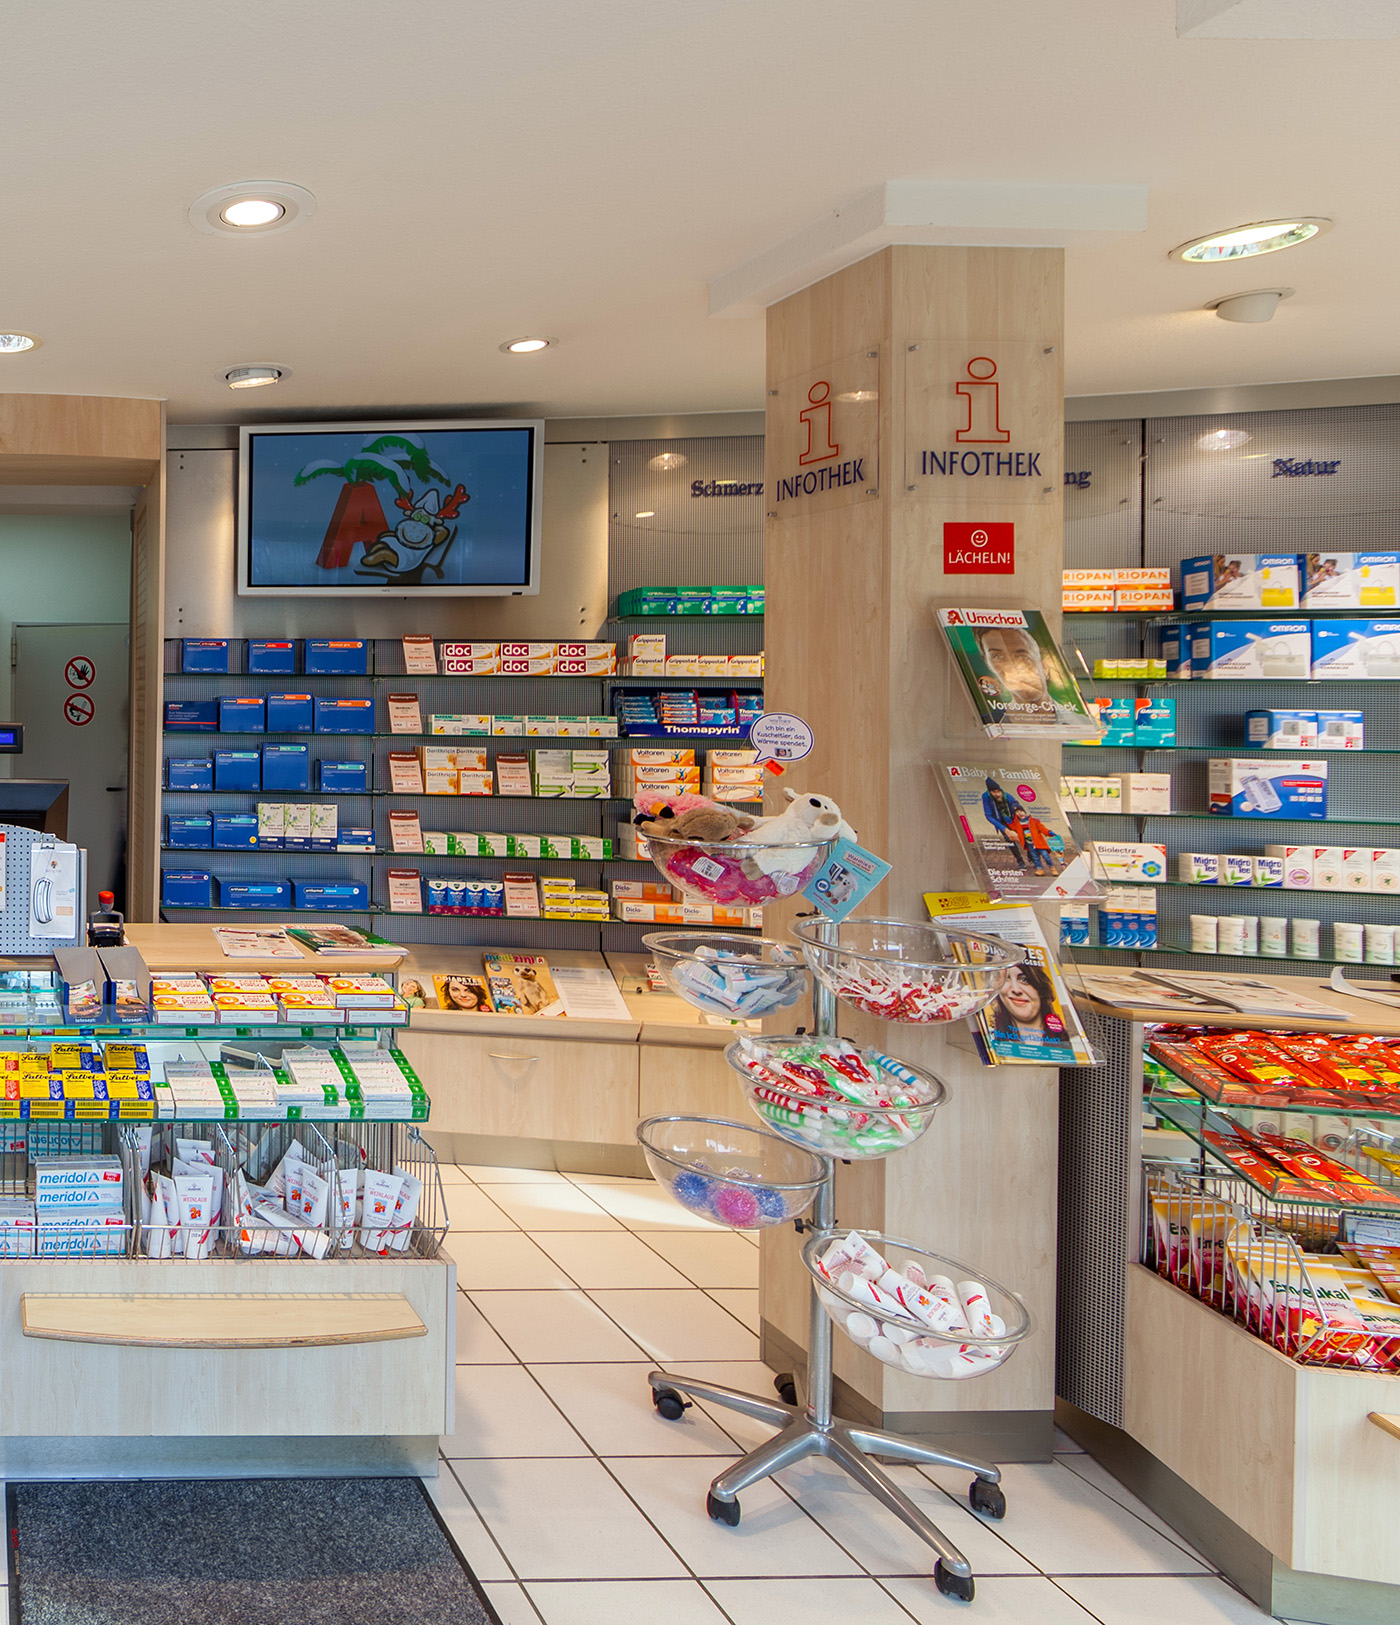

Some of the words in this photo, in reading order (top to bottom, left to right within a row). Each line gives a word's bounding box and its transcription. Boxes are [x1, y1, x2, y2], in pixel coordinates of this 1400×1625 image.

[921, 451, 1042, 477] INFOTHEK
[1271, 458, 1341, 479] Natur
[776, 458, 864, 502] INFOTHEK
[691, 480, 764, 497] Schmerz
[948, 549, 1011, 565] LÄCHELN!
[1064, 572, 1112, 581] RIOPAN
[1117, 570, 1168, 580] RIOPAN
[1064, 593, 1113, 602] RIOPAN
[1121, 591, 1171, 601] RIOPAN
[966, 612, 1023, 626] Umschau
[504, 645, 527, 655] doc
[560, 645, 585, 655] doc
[448, 660, 471, 670] doc
[560, 661, 585, 671] doc
[988, 700, 1078, 714] Vorsorge-Check
[665, 725, 739, 734] Thomapyrin
[757, 732, 792, 740] Kuscheltier,
[780, 740, 807, 748] spendet.
[962, 768, 988, 778] Baby
[1000, 769, 1041, 780] Familie
[1098, 845, 1137, 854] Biolectra
[847, 853, 872, 869] Warmies
[1194, 857, 1217, 867] Migro
[1228, 858, 1251, 868] Migro
[1258, 859, 1282, 870] Migro
[1204, 864, 1217, 872] Tee
[1239, 866, 1251, 874] Tee
[1270, 867, 1282, 875] Tee
[486, 954, 535, 964] medizini
[40, 1172, 87, 1184] meridol
[40, 1191, 87, 1203] meridol
[369, 1189, 394, 1200] WEINLAUB
[41, 1238, 89, 1251] meridol
[1269, 1280, 1351, 1301] Em-eukal
